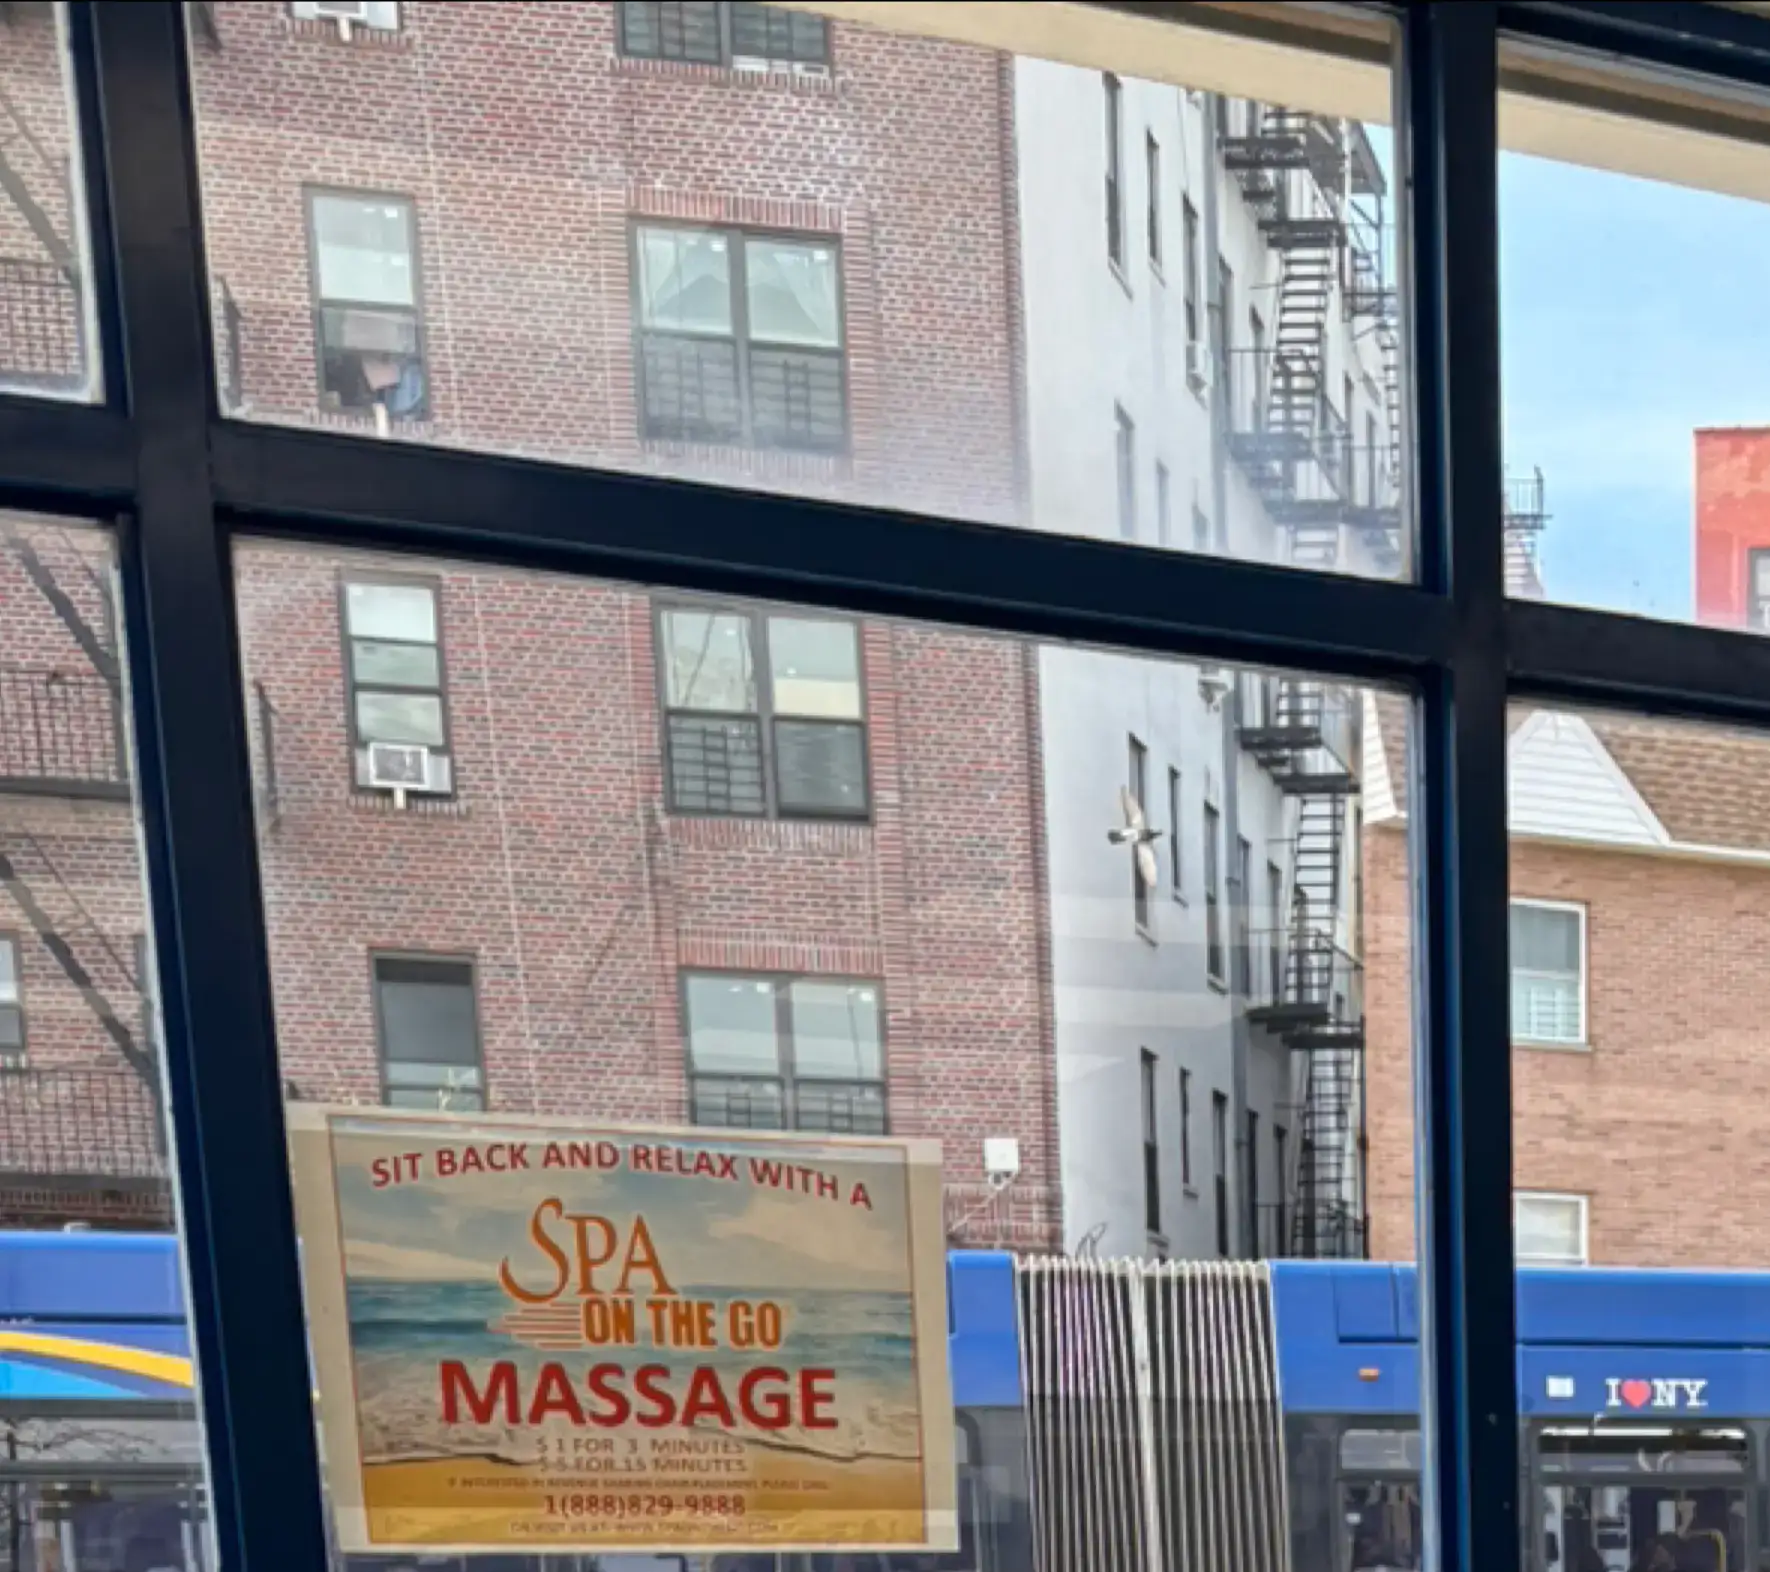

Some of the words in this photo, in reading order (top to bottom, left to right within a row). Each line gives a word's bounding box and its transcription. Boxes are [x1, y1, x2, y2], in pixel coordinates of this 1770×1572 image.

[371, 1152, 423, 1188] SIT
[436, 1142, 530, 1177] BACK
[542, 1140, 620, 1169] AND
[632, 1143, 739, 1181] RELAX
[750, 1157, 839, 1200] WITH
[850, 1182, 873, 1211] A
[500, 1197, 679, 1303] SPA
[583, 1299, 637, 1344] ON
[647, 1300, 717, 1346] THE
[729, 1301, 782, 1347] GO
[440, 1360, 839, 1429] MASSAGE
[573, 1438, 614, 1452] FOR
[652, 1438, 745, 1454] MINUTES
[574, 1457, 614, 1471] FOR
[652, 1457, 747, 1472] MINUTES
[544, 1494, 746, 1518] 1(888)829-9888
